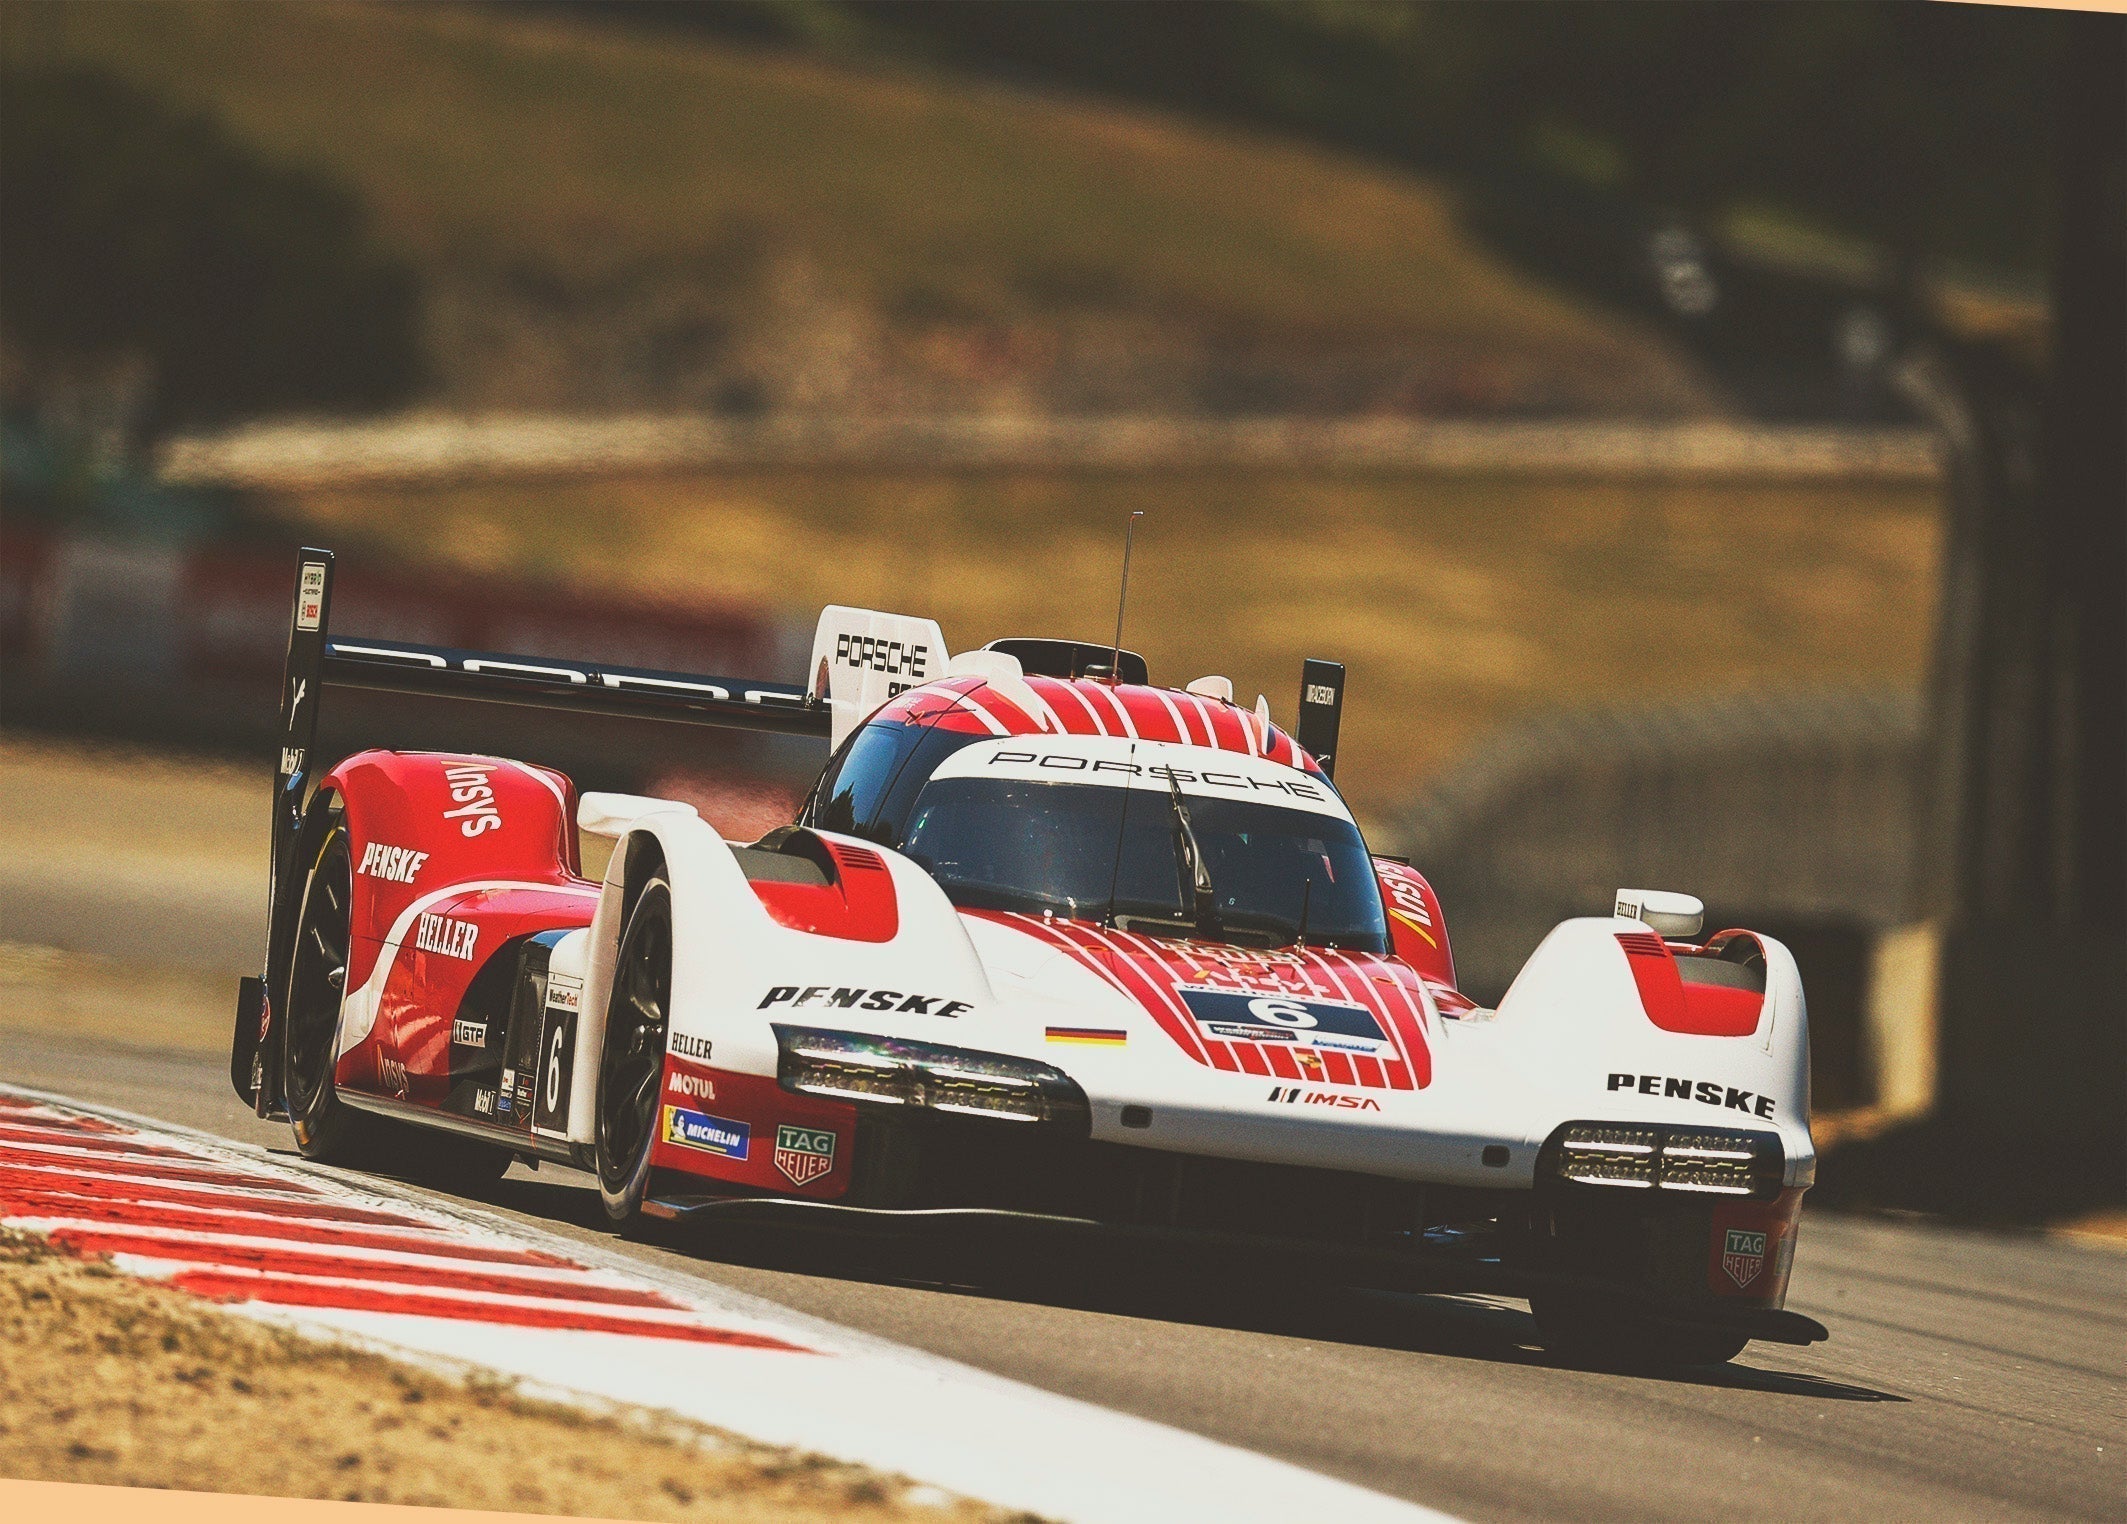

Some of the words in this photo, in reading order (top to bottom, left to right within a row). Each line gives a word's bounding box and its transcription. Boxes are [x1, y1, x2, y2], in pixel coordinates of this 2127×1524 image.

[835, 633, 928, 678] PORSCHE
[988, 751, 1326, 802] PORSCHE
[440, 760, 502, 838] Ansys
[356, 841, 430, 884] PENSKE
[1616, 901, 1638, 920] HELLER
[415, 911, 479, 962] HELLER
[756, 986, 975, 1019] PENSKE
[1247, 997, 1319, 1029] 6
[462, 1025, 484, 1043] GTP
[671, 1031, 713, 1060] HELLER
[546, 1025, 563, 1113] 6
[668, 1072, 716, 1101] MOTUL
[1304, 1092, 1381, 1112] IMSA
[1607, 1073, 1776, 1121] PENSKE
[686, 1123, 741, 1147] MICHELIN
[781, 1129, 830, 1153] TAG
[777, 1150, 829, 1181] HEUER
[1730, 1234, 1763, 1254] TAG
[1725, 1256, 1761, 1284] HEUER
